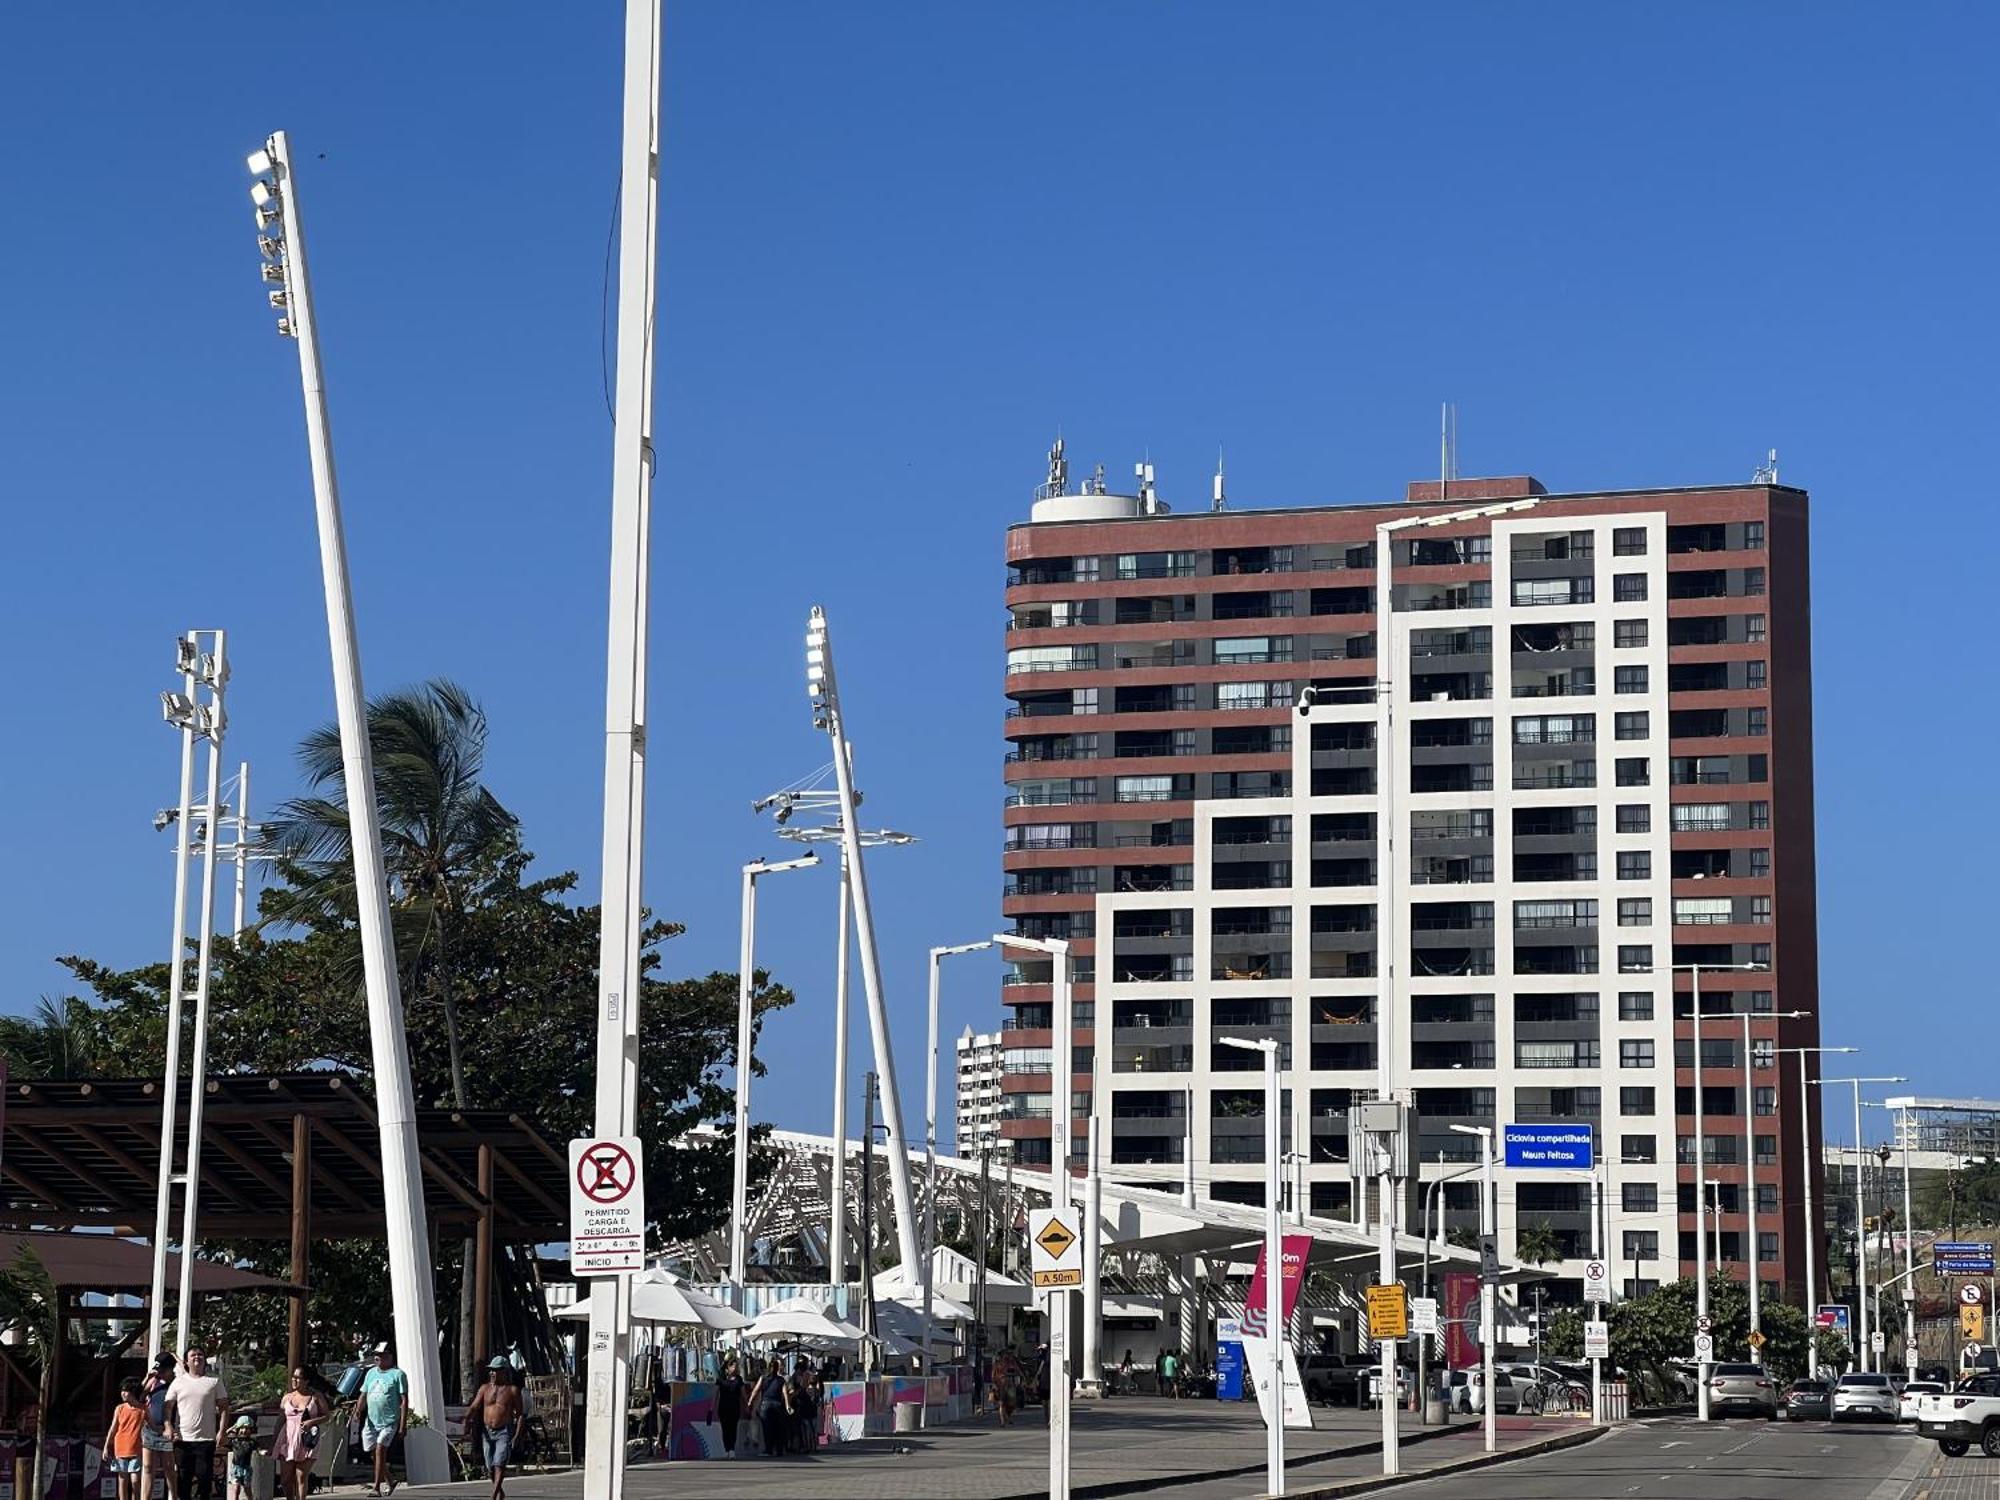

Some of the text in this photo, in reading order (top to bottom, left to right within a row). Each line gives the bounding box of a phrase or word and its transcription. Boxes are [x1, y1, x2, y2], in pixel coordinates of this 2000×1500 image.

[1506, 1134, 1590, 1144] Ciclovia compartilhada
[1522, 1150, 1575, 1160] Mauro Feitosa
[584, 1208, 630, 1217] PERMITIDO
[588, 1218, 618, 1226] CARGA
[584, 1227, 630, 1235] DESCARGA
[1042, 1273, 1073, 1284] A 50m
